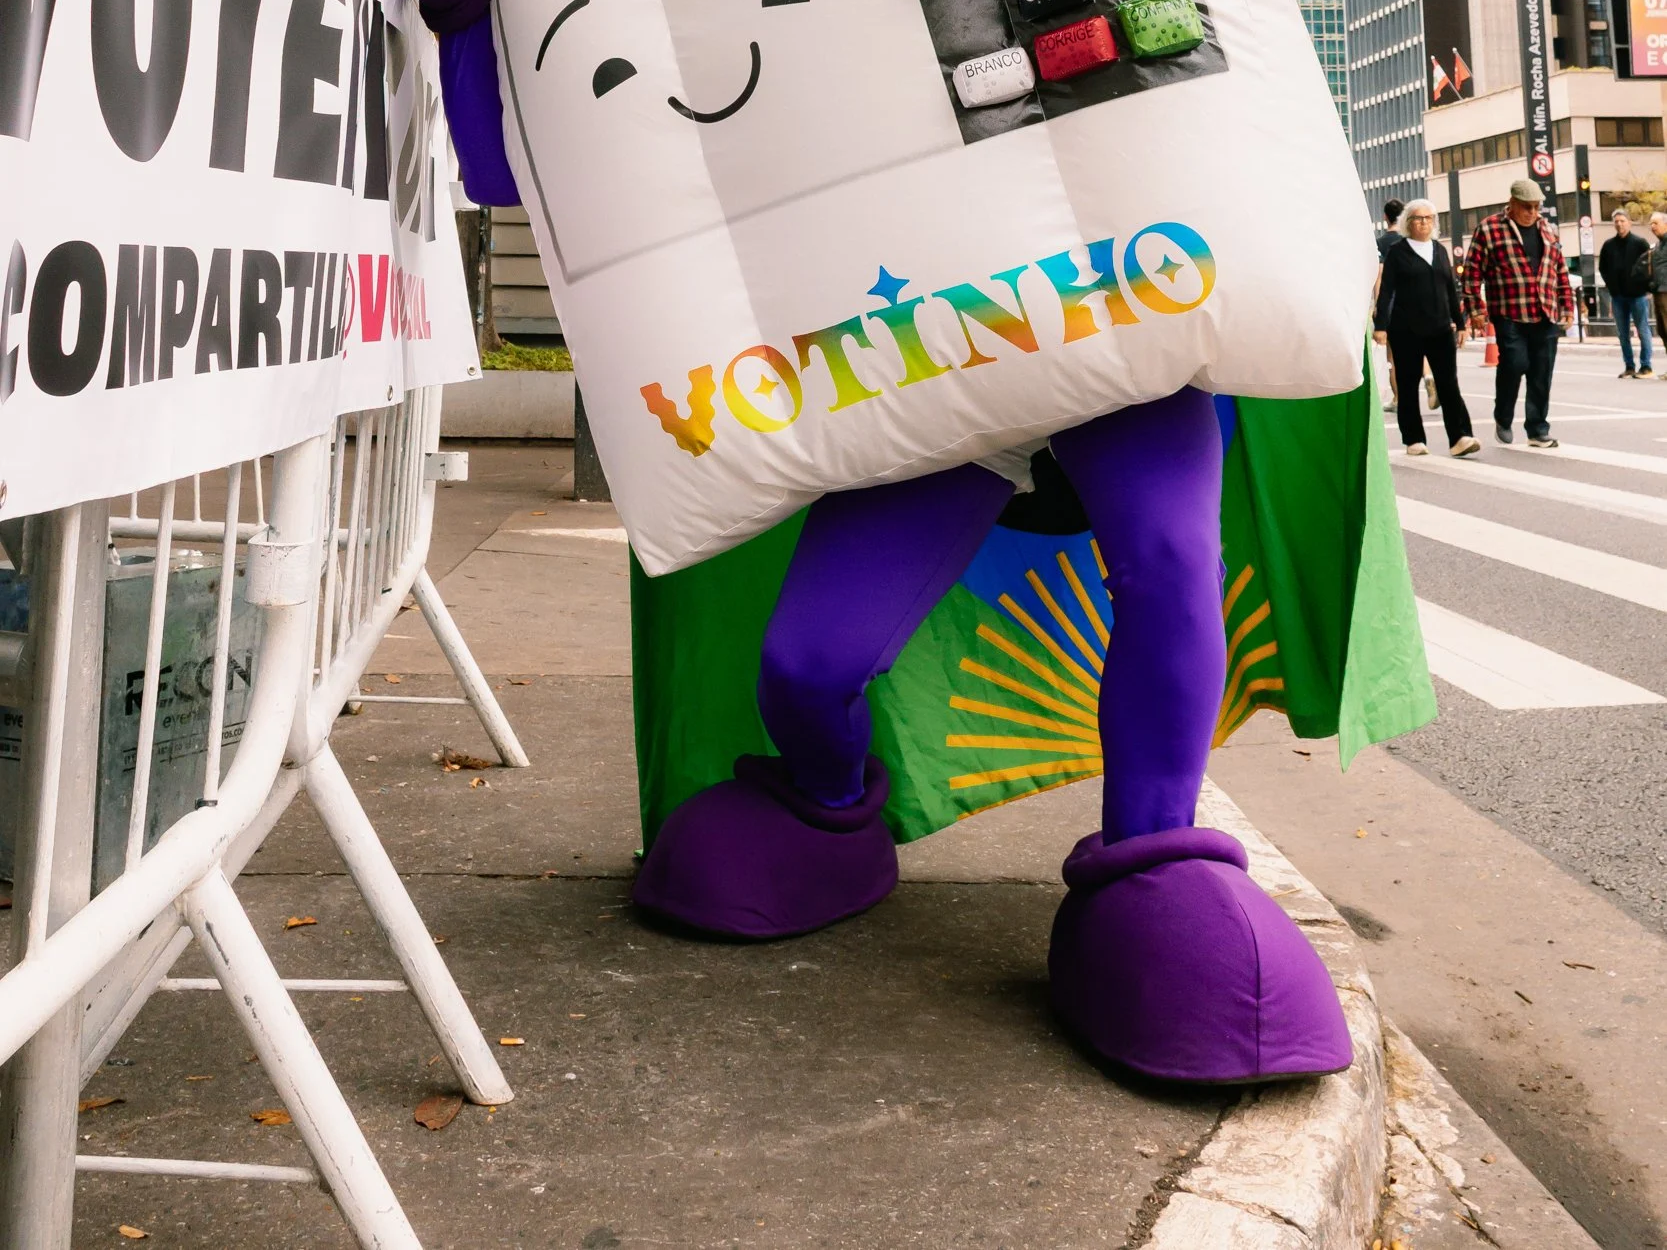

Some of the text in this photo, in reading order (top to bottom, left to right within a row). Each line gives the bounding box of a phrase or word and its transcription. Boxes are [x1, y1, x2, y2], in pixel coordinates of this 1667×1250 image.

[964, 51, 1022, 79] BRANCO
[1038, 23, 1096, 52] CORRIGE
[1530, 57, 1545, 100] Rocha
[1533, 102, 1547, 131] Min.
[1535, 134, 1549, 155] Al.
[639, 220, 1218, 458] VOTINHO
